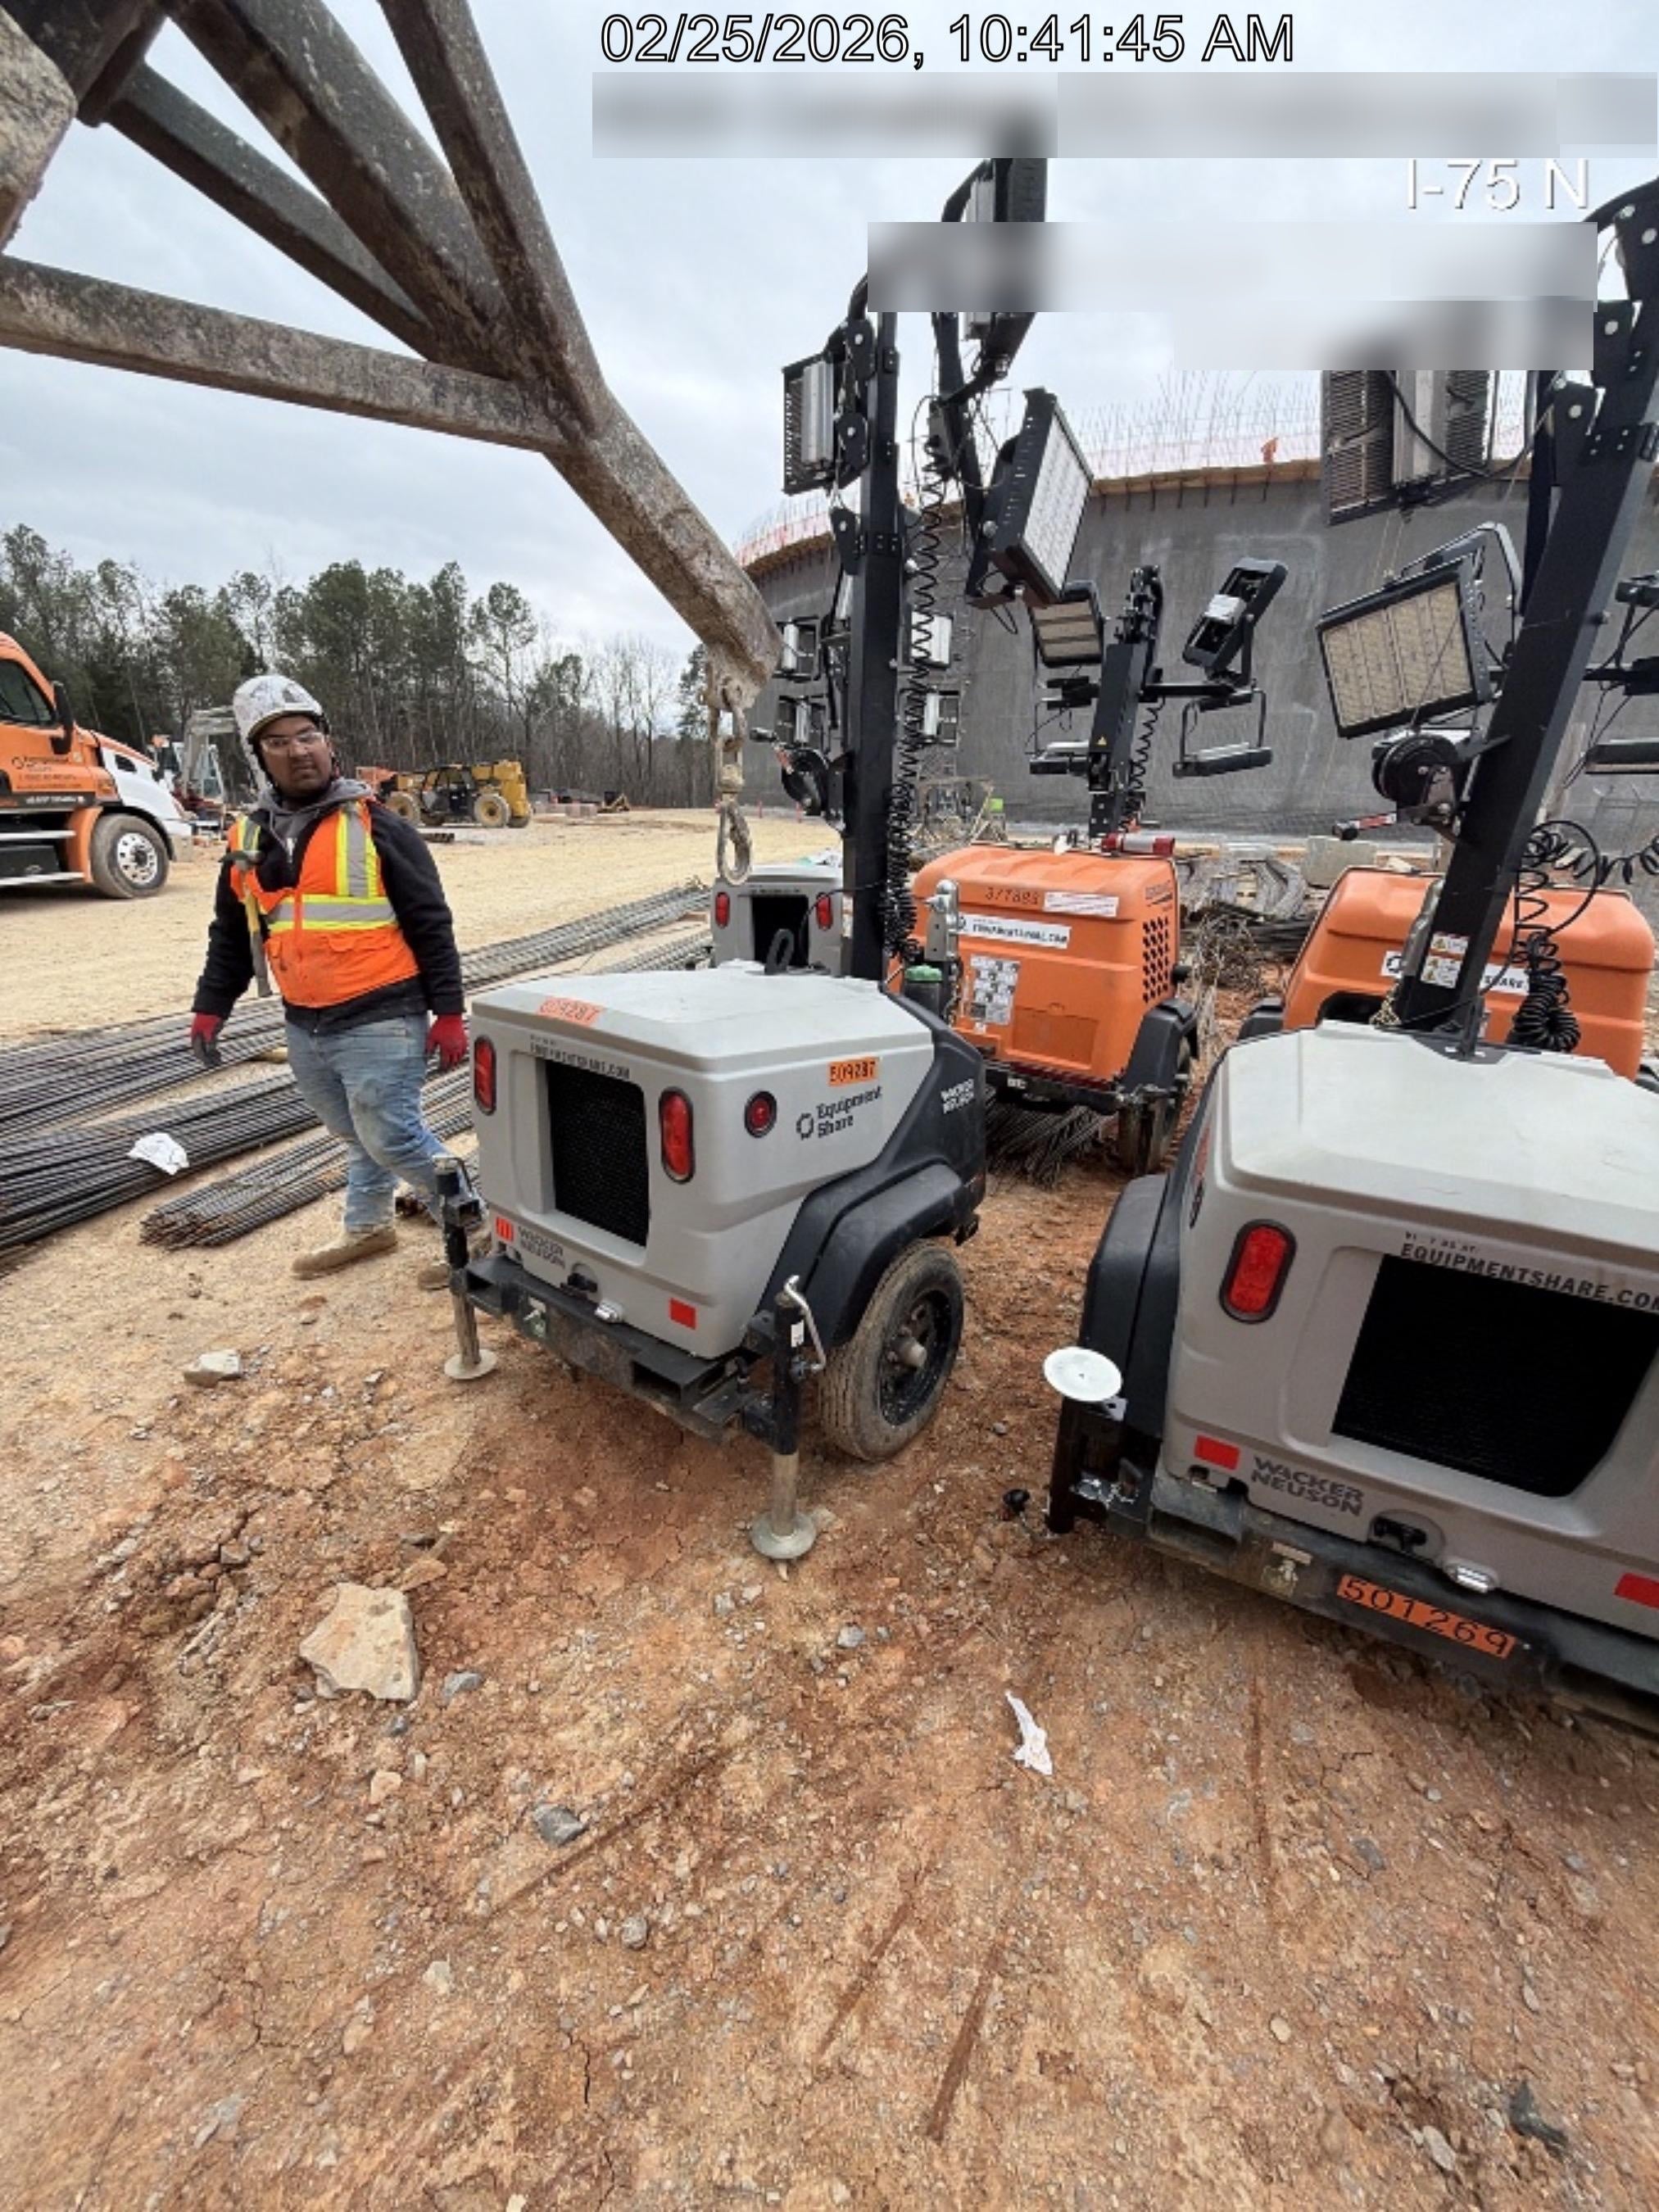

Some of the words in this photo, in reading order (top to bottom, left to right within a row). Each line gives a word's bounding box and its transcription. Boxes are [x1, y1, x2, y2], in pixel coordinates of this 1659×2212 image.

[817, 1114, 854, 1138] Share
[1250, 1470, 1363, 1516] NEUSON
[1253, 1455, 1365, 1503] WACKER
[1343, 1578, 1508, 1655] 501269
